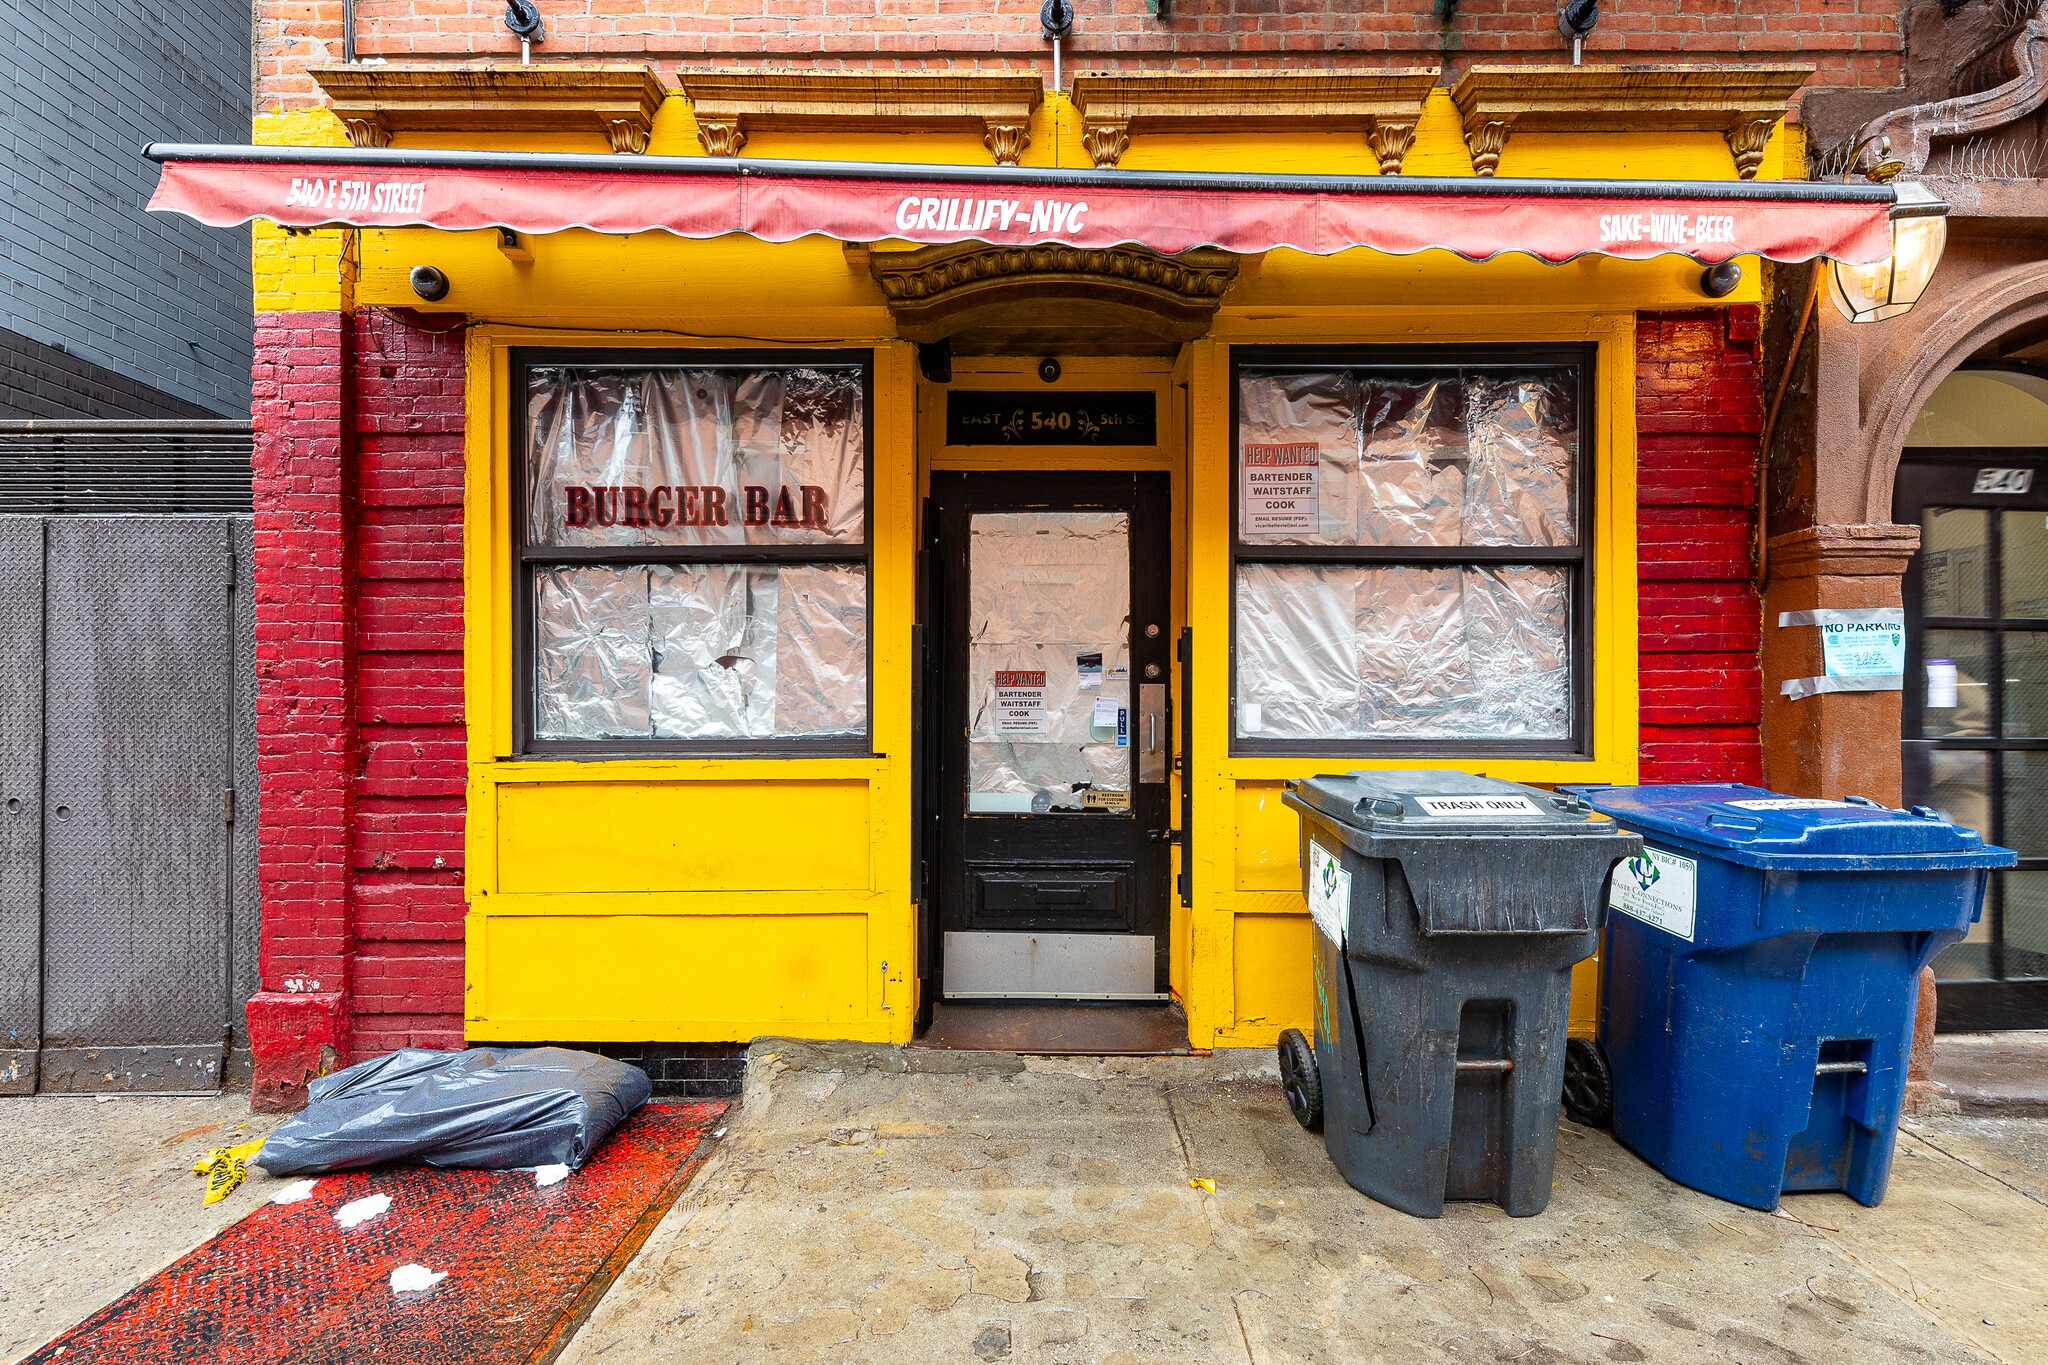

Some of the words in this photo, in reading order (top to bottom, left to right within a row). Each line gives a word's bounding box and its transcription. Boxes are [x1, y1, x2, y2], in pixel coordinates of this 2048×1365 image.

[285, 178, 324, 208] 540
[324, 179, 337, 209] E
[338, 181, 371, 211] 5TH
[371, 182, 426, 214] STREET
[896, 196, 1089, 234] GRILLIFY-NYC
[1600, 213, 1736, 244] SAKE-WINE-BEER
[961, 413, 1002, 424] EAST
[1031, 412, 1071, 430] 540
[1100, 413, 1122, 425] 5th
[1247, 447, 1272, 465] HELP
[1273, 446, 1316, 465] WANTED
[1250, 472, 1313, 482] BARTENDER
[1253, 487, 1312, 495] WAITSTAFF
[565, 486, 729, 527] BURGER
[744, 485, 828, 527] BAR
[1265, 501, 1296, 509] COOK
[1825, 623, 1844, 633] NO
[1847, 622, 1901, 632] PARKING
[997, 673, 1014, 686] HELP
[1016, 673, 1045, 686] WANTED
[1427, 801, 1484, 810] TRASH
[1485, 801, 1528, 810] ONLY
[1651, 852, 1661, 861] NY
[1661, 855, 1677, 866] BIC#
[1679, 860, 1693, 872] 1059
[1612, 878, 1631, 892] WASTE
[1632, 886, 1683, 913] CONNECTIONS
